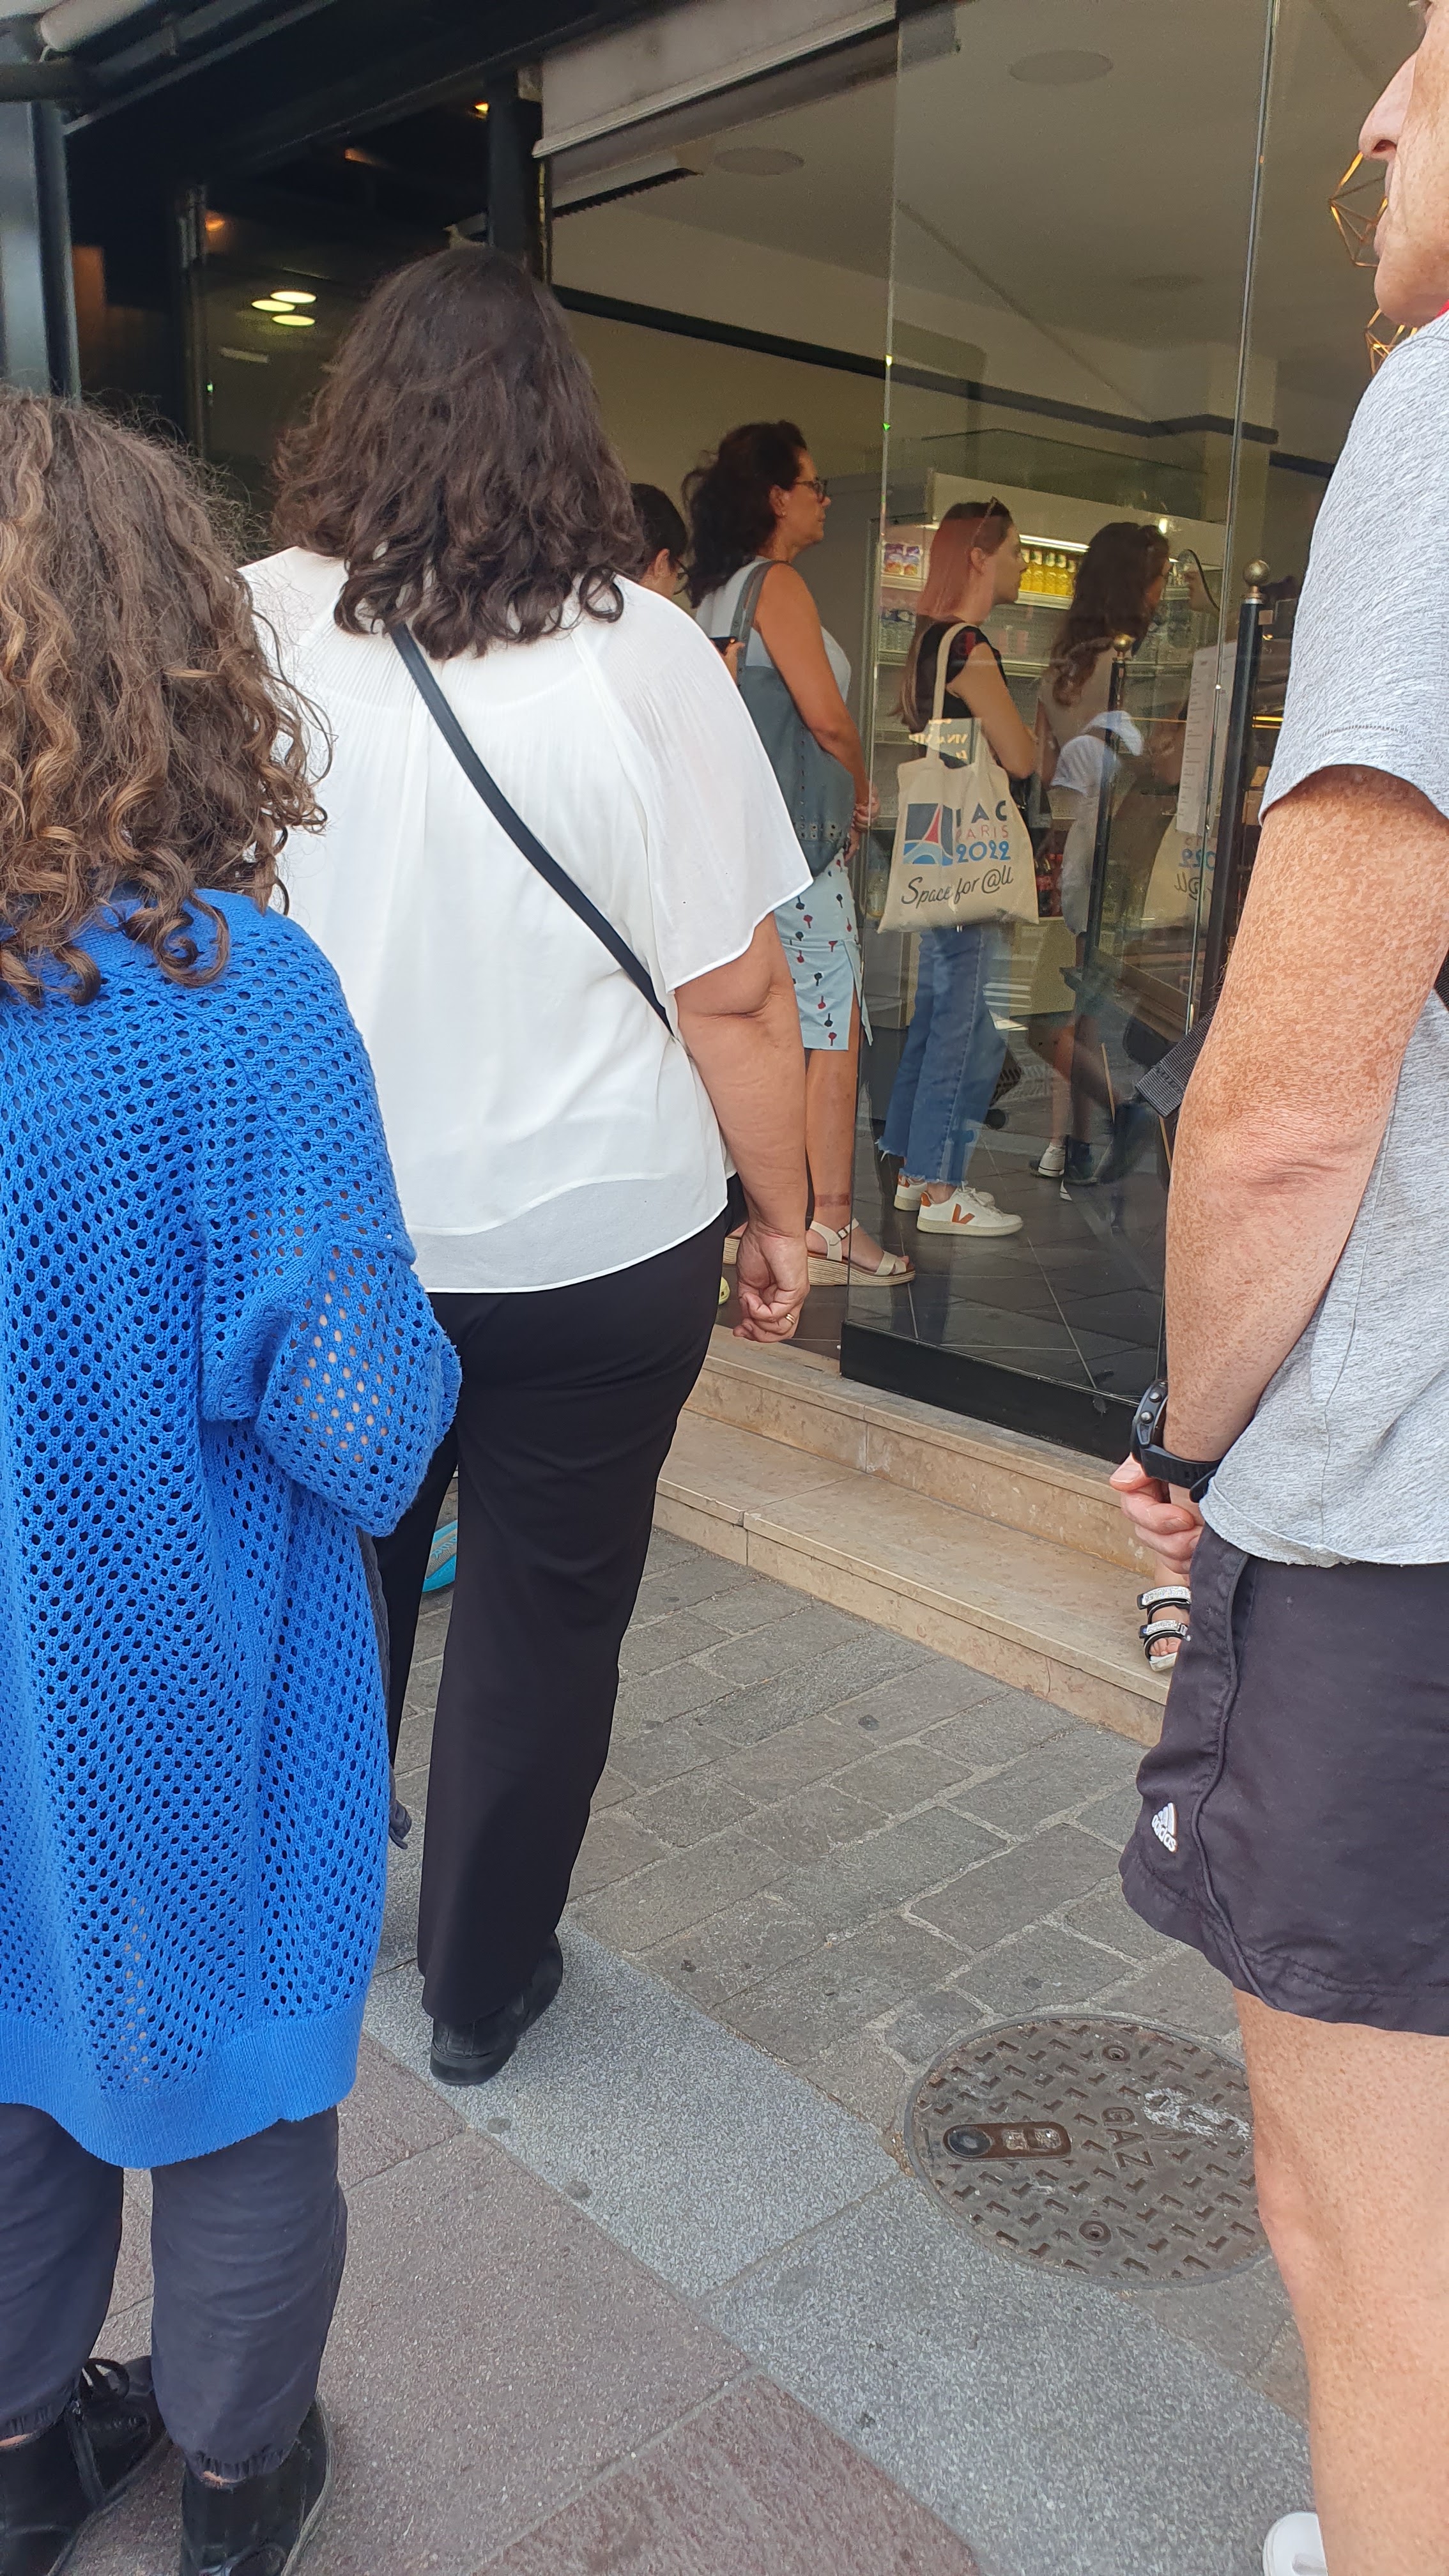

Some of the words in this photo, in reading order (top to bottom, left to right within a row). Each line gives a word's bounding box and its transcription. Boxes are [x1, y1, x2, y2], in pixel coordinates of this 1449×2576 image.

[956, 800, 1008, 828] IAC
[956, 839, 1011, 863] 2022
[901, 876, 951, 909] Space
[953, 877, 981, 905] for
[981, 864, 1014, 894] @ll
[1151, 1814, 1176, 1852] adidas
[1101, 2106, 1156, 2171] GAZ
